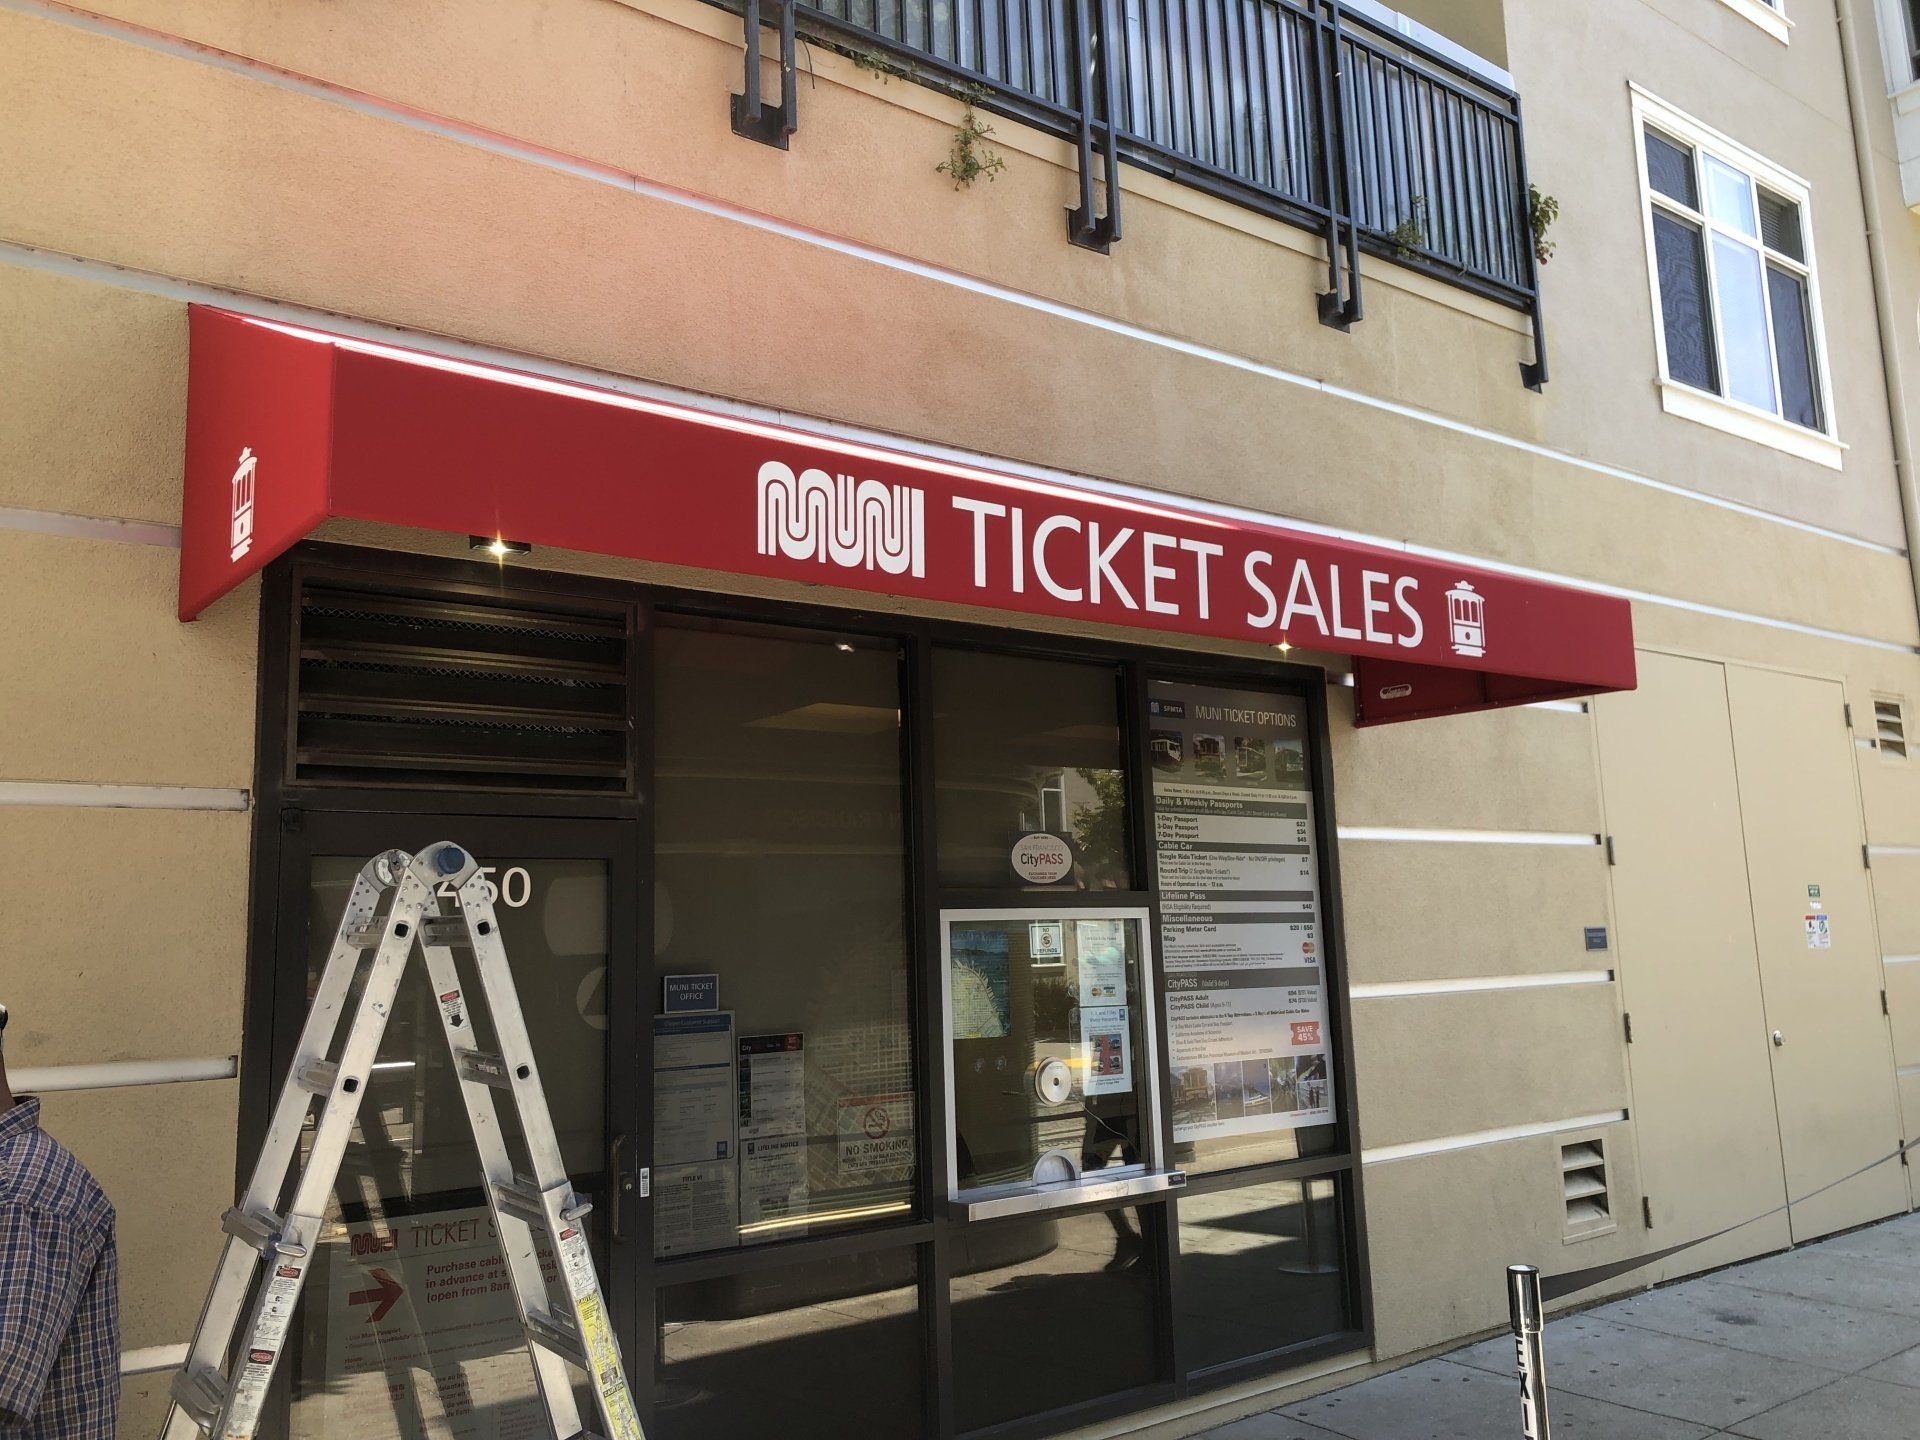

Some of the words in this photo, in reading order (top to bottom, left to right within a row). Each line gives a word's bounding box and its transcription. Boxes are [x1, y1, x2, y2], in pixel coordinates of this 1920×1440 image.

[757, 460, 926, 578] MUNI
[952, 495, 1224, 620] TICKET
[1243, 550, 1424, 648] SALES
[1163, 705, 1183, 713] SFMTA
[1195, 705, 1222, 721] MUNI
[1223, 708, 1255, 724] TICKET
[1257, 711, 1296, 727] OPTIONS
[1156, 796, 1174, 806] Daily
[1183, 799, 1208, 808] Weekly
[1210, 800, 1243, 809] Passports
[1157, 815, 1172, 823] 1-Day
[1174, 815, 1198, 823] Passport
[1174, 823, 1198, 831] Passport
[1158, 841, 1179, 849] Cable
[1180, 842, 1192, 850] Car
[1020, 853, 1063, 867] CityPASS
[1159, 852, 1176, 860] Single
[1161, 891, 1188, 899] Lifeline
[1190, 892, 1206, 900] Pass
[1162, 914, 1213, 922] Miscellaneous
[669, 983, 688, 991] MUNI
[691, 982, 713, 990] TICKET
[1167, 979, 1198, 990] CityPASS
[680, 992, 703, 1000] OFFICE
[1169, 995, 1194, 1003] CityPASS
[1170, 1003, 1194, 1011] CityPASS
[1296, 1025, 1313, 1033] SAVE
[1297, 1032, 1313, 1041] 45%
[845, 1144, 859, 1156] NO
[863, 1139, 907, 1153] SMOKING
[410, 1218, 479, 1248] TICKET
[427, 1261, 477, 1275] Purchase
[479, 1254, 504, 1268] cabl
[426, 1279, 436, 1289] in
[440, 1271, 486, 1287] advance
[487, 1270, 498, 1279] at
[427, 1288, 460, 1303] (open
[462, 1285, 488, 1296] from
[1515, 1338, 1534, 1440] EXI
